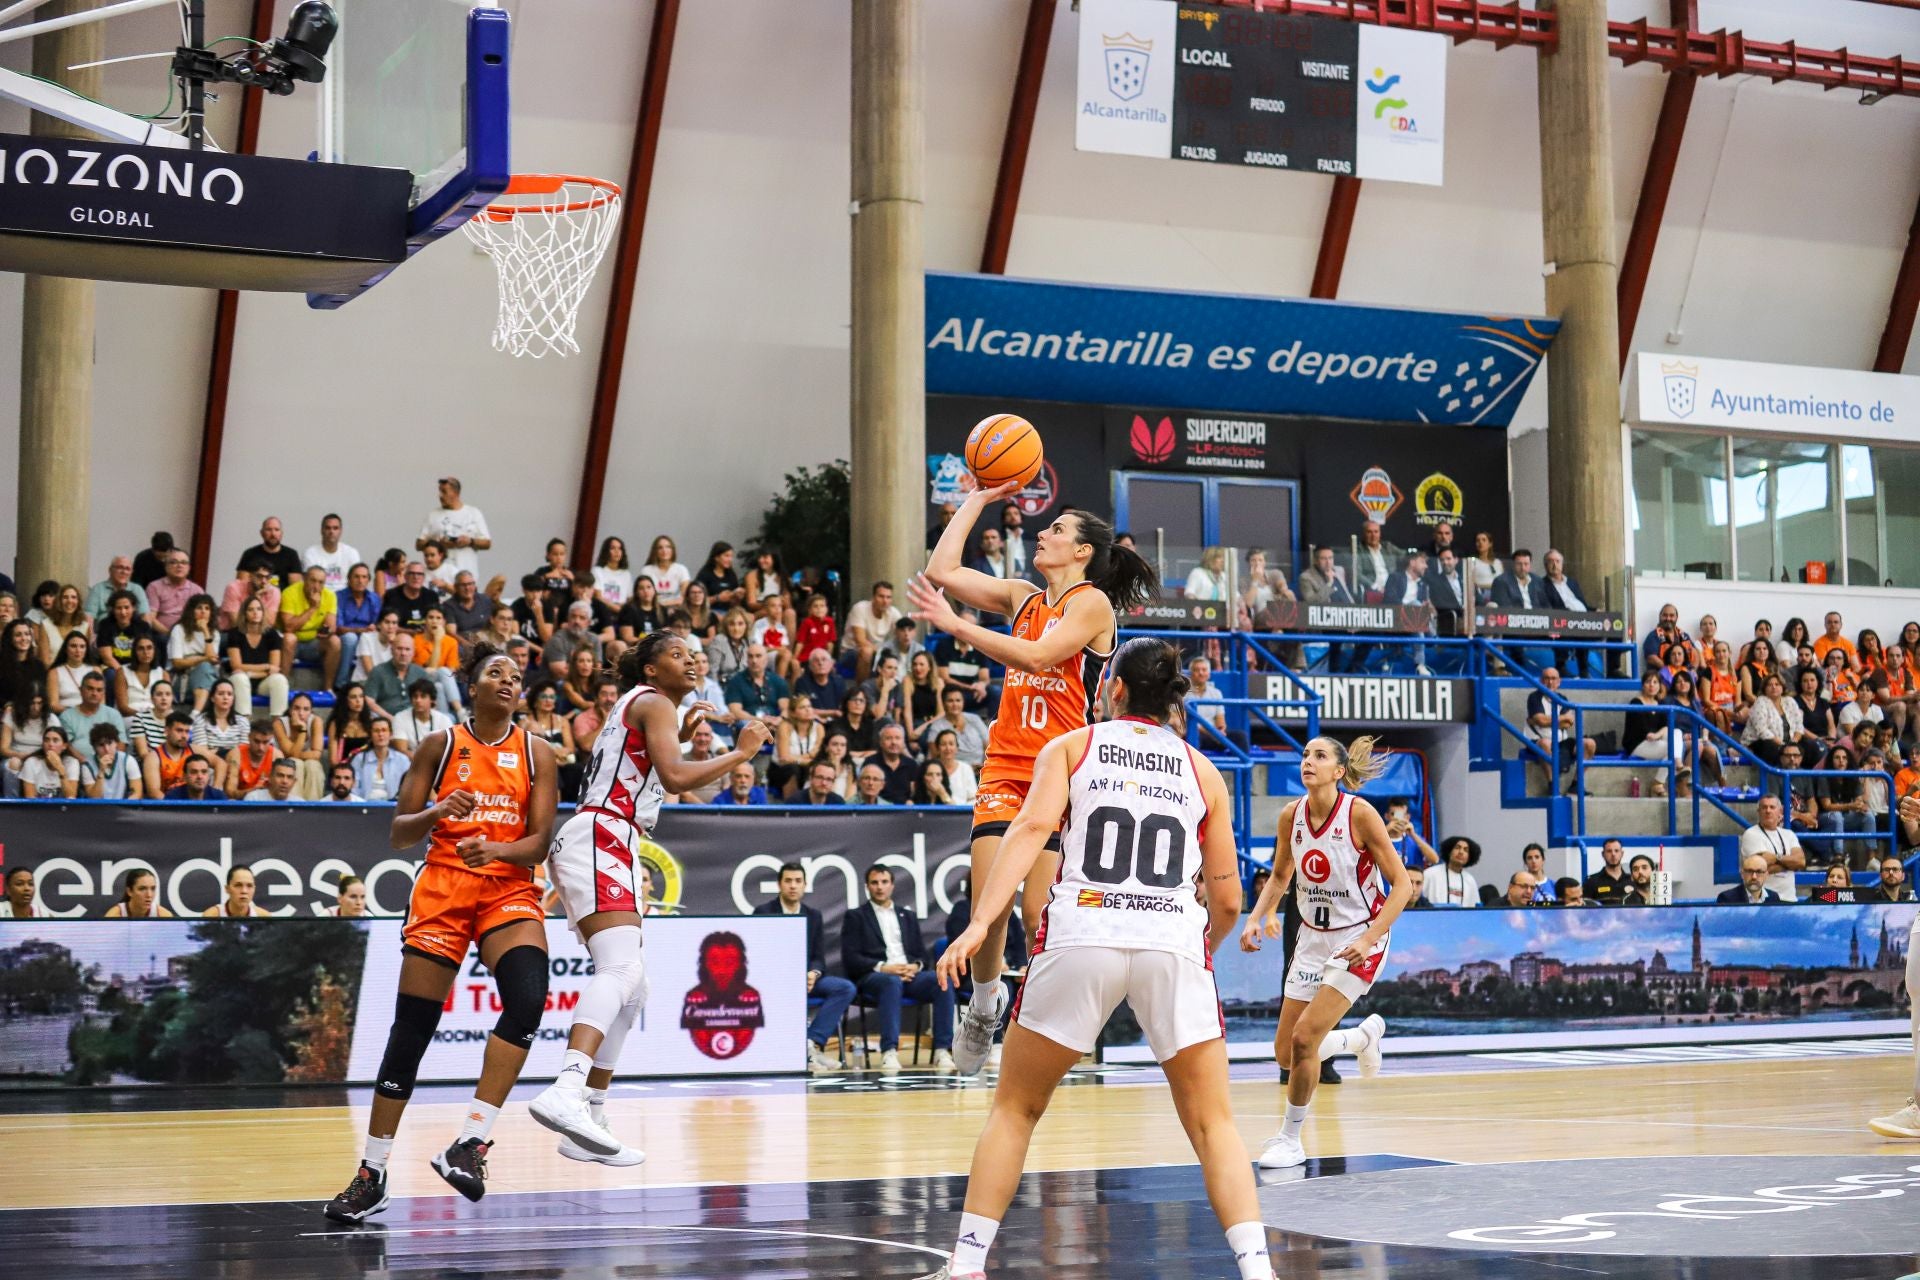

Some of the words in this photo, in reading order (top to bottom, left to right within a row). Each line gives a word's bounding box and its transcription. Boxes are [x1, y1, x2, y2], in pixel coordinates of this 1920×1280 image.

[1182, 48, 1232, 68] LOCAL
[1302, 61, 1349, 81] VISITANTE
[1082, 100, 1168, 125] Alcantarilla
[1250, 97, 1285, 114] PERIODO
[1181, 145, 1216, 161] FALTAS
[1244, 150, 1288, 167] JUGADOR
[1317, 158, 1351, 174] FALTAS
[70, 206, 154, 228] GLOBAL
[927, 317, 1194, 368] Alcantarilla
[1207, 344, 1256, 371] es
[1267, 340, 1438, 385] deporte
[1710, 388, 1862, 420] Ayuntamiento
[1869, 401, 1895, 423] de
[1186, 418, 1266, 445] SUPERCOPA
[1186, 456, 1243, 468] ALCANTARILLA
[1145, 605, 1187, 618] endesa
[1308, 605, 1394, 628] ALCANTARILLA
[1507, 614, 1549, 629] SUPERCOPA
[1554, 618, 1567, 629] LF
[1567, 618, 1603, 631] endesa
[1021, 695, 1048, 729] 10
[1099, 744, 1183, 777] GERVASINI
[1113, 781, 1189, 806] HORIZON
[1082, 806, 1186, 889] 00
[1103, 898, 1121, 909] DE
[1838, 891, 1856, 902] POSS.
[1314, 906, 1330, 928] 4
